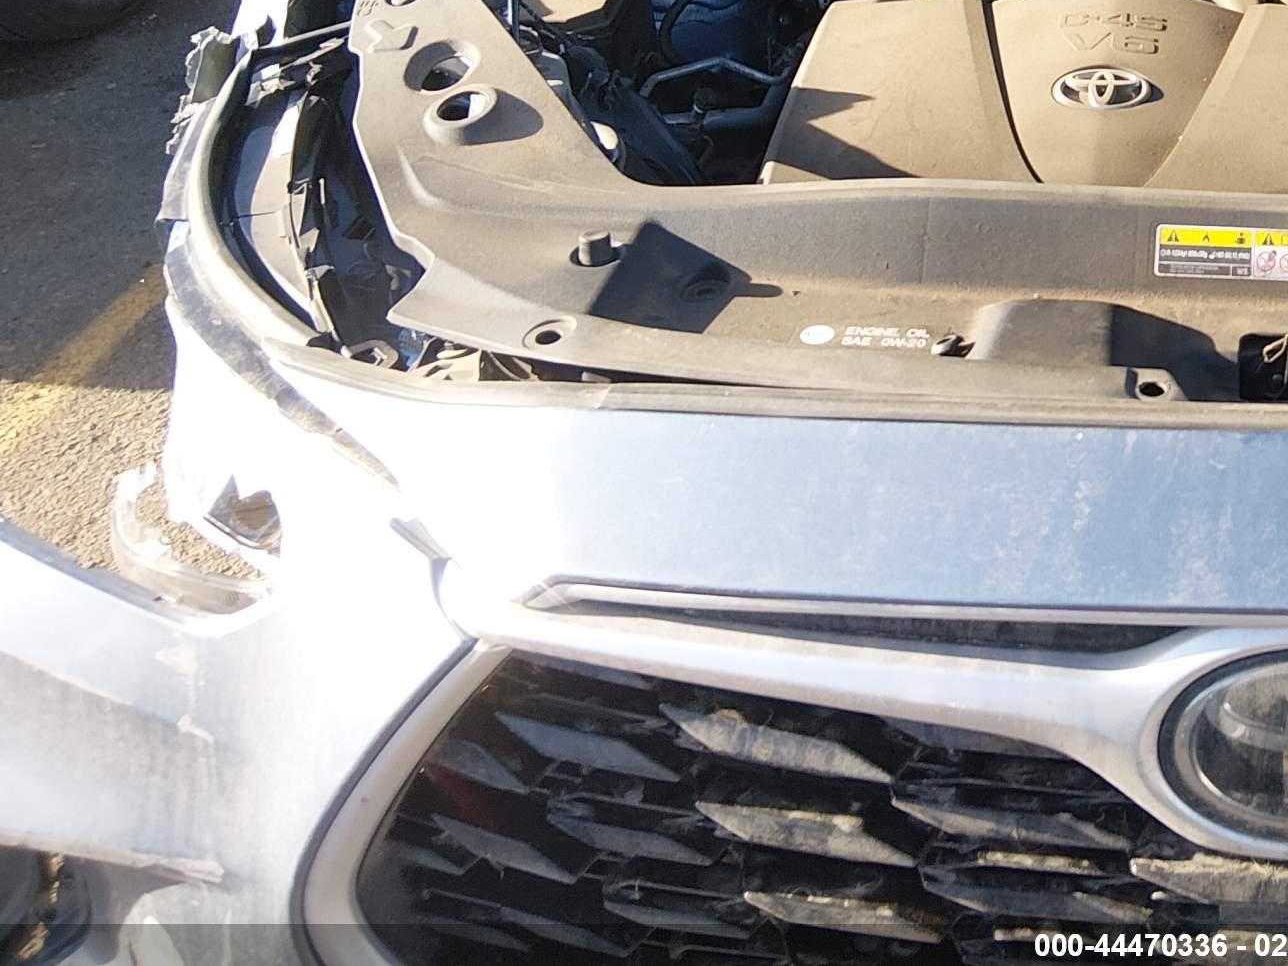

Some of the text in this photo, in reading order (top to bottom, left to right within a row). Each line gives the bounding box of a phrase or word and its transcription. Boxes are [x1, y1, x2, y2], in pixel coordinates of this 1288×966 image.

[1064, 32, 1160, 54] V6
[845, 326, 930, 338] ENGINE OIL
[841, 336, 927, 347] SAE 0W-20
